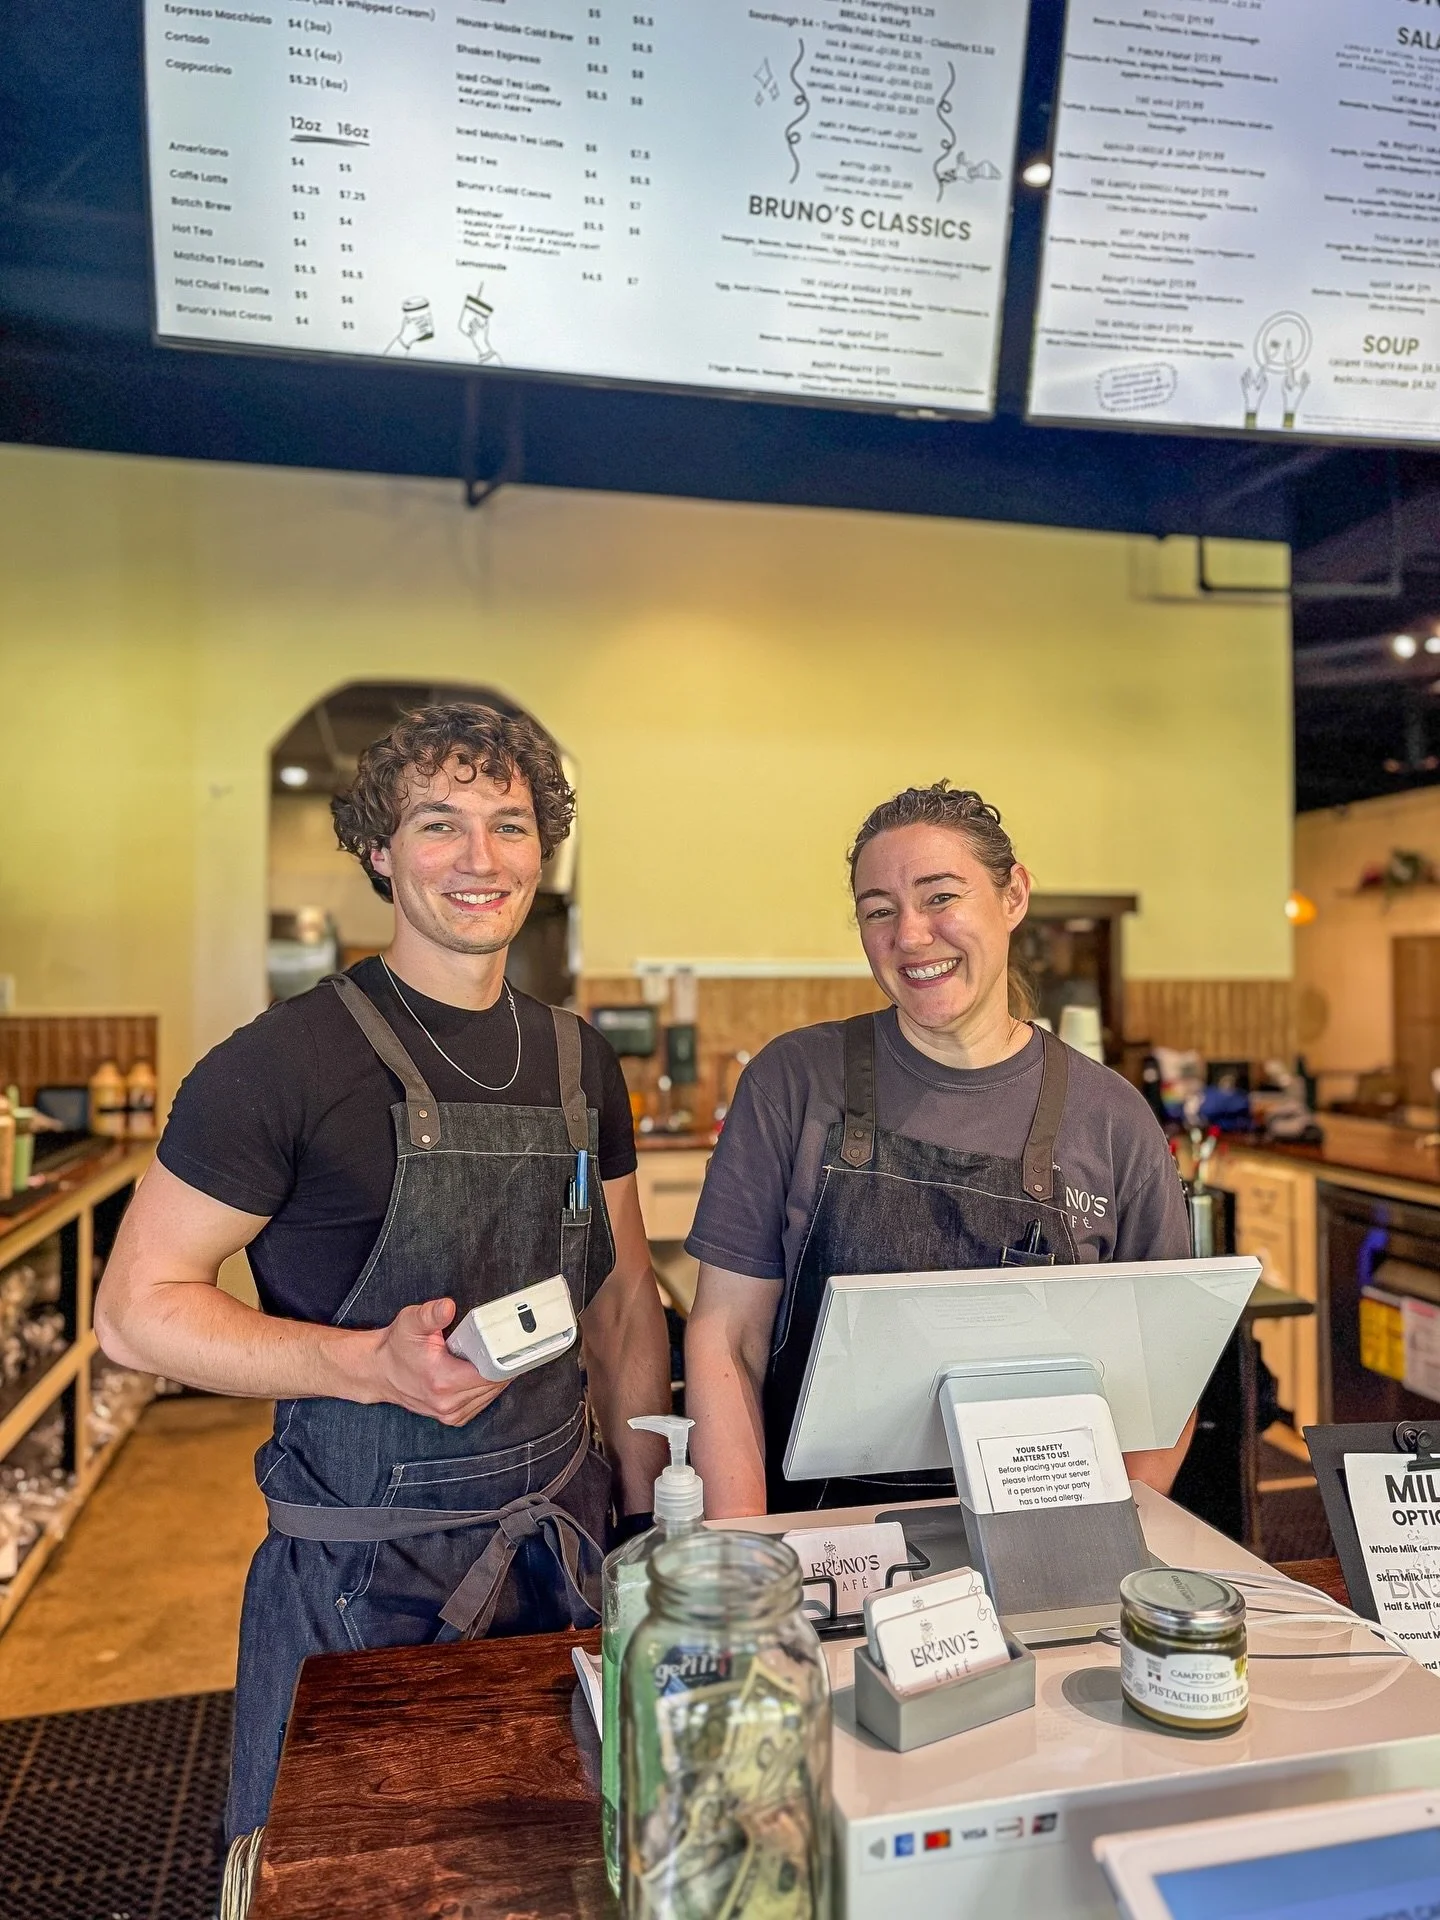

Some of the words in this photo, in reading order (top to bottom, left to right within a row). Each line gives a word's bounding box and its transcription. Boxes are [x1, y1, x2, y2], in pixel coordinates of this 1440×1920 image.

[164, 4, 213, 16] Espresso
[214, 10, 272, 25] Macchiato
[288, 18, 302, 28] $4
[456, 17, 521, 34] House-Made
[524, 26, 547, 38] Cold
[549, 30, 574, 42] Brew
[1397, 26, 1440, 51] SAL
[165, 31, 210, 45] Cortado
[288, 46, 312, 58] $4.5
[456, 44, 494, 57] Shaken
[496, 50, 541, 64] Espresso
[165, 58, 232, 75] Cappuccino
[456, 72, 477, 84] Iced
[480, 74, 503, 86] Chai
[506, 78, 523, 89] Tea
[526, 81, 550, 93] Latte
[290, 116, 322, 132] 12oz
[337, 122, 369, 138] 16oz
[456, 126, 477, 137] Iced
[480, 129, 517, 143] Matcha
[520, 134, 537, 145] Tea
[539, 136, 564, 149] Latte
[169, 142, 229, 157] Americano
[292, 157, 304, 166] $4
[456, 153, 477, 164] Iced
[480, 156, 498, 167] Tea
[201, 172, 228, 184] Latte
[456, 180, 494, 192] Bruno's
[497, 184, 518, 196] Cold
[521, 188, 552, 200] Cocoa
[171, 196, 203, 208] Batch
[205, 200, 232, 212] Brew
[340, 217, 352, 226] $4
[456, 206, 503, 219] Refresher
[749, 196, 854, 227] BRUNO'S
[860, 210, 971, 240] CLASSICS
[172, 224, 191, 234] Hot
[193, 226, 213, 236] Tea
[294, 238, 306, 247] $4
[174, 251, 215, 264] Matcha
[218, 255, 236, 266] Tea
[238, 258, 264, 270] Latte
[456, 259, 507, 271] Lemonade
[174, 277, 193, 288] Hot
[195, 278, 220, 291] Chai
[223, 282, 241, 293] Tea
[243, 284, 270, 296] Latte
[176, 304, 217, 316] Bruno's
[218, 306, 237, 318] Hot
[239, 310, 272, 322] Cocoa
[296, 316, 308, 325] $4
[1363, 334, 1420, 356] SOUP
[1065, 1186, 1108, 1217] NO'S
[1012, 1452, 1045, 1463] MATTERS
[1057, 1450, 1070, 1459] US!
[1016, 1446, 1036, 1454] YOUR
[1037, 1443, 1063, 1452] SAFETY
[998, 1465, 1022, 1474] Before
[1022, 1463, 1050, 1472] placing
[1050, 1462, 1066, 1471] your
[1068, 1458, 1089, 1467] order,
[1002, 1476, 1026, 1486] please
[1027, 1473, 1050, 1482] inform
[1051, 1473, 1068, 1482] your
[1069, 1470, 1090, 1478] server
[1020, 1486, 1045, 1496] person
[1054, 1484, 1071, 1494] your
[1072, 1481, 1091, 1491] party
[1059, 1494, 1085, 1502] allergy.
[1385, 1474, 1440, 1503] MIL
[1369, 1545, 1398, 1553] Whole
[1400, 1544, 1418, 1553] Milk
[811, 1554, 880, 1578] BRUNO'S
[842, 1576, 869, 1592] AFÉ
[1376, 1573, 1400, 1582] Skim
[1401, 1572, 1420, 1582] Milk
[1384, 1602, 1402, 1611] Half
[1412, 1601, 1431, 1610] Half
[1394, 1631, 1432, 1640] oconut
[910, 1630, 979, 1668] BRUNO'S
[935, 1660, 971, 1684] CAFÉ
[1170, 1669, 1204, 1680] CAMPO
[1148, 1682, 1209, 1703] PISTACHIO
[962, 1828, 988, 1841] VISA
